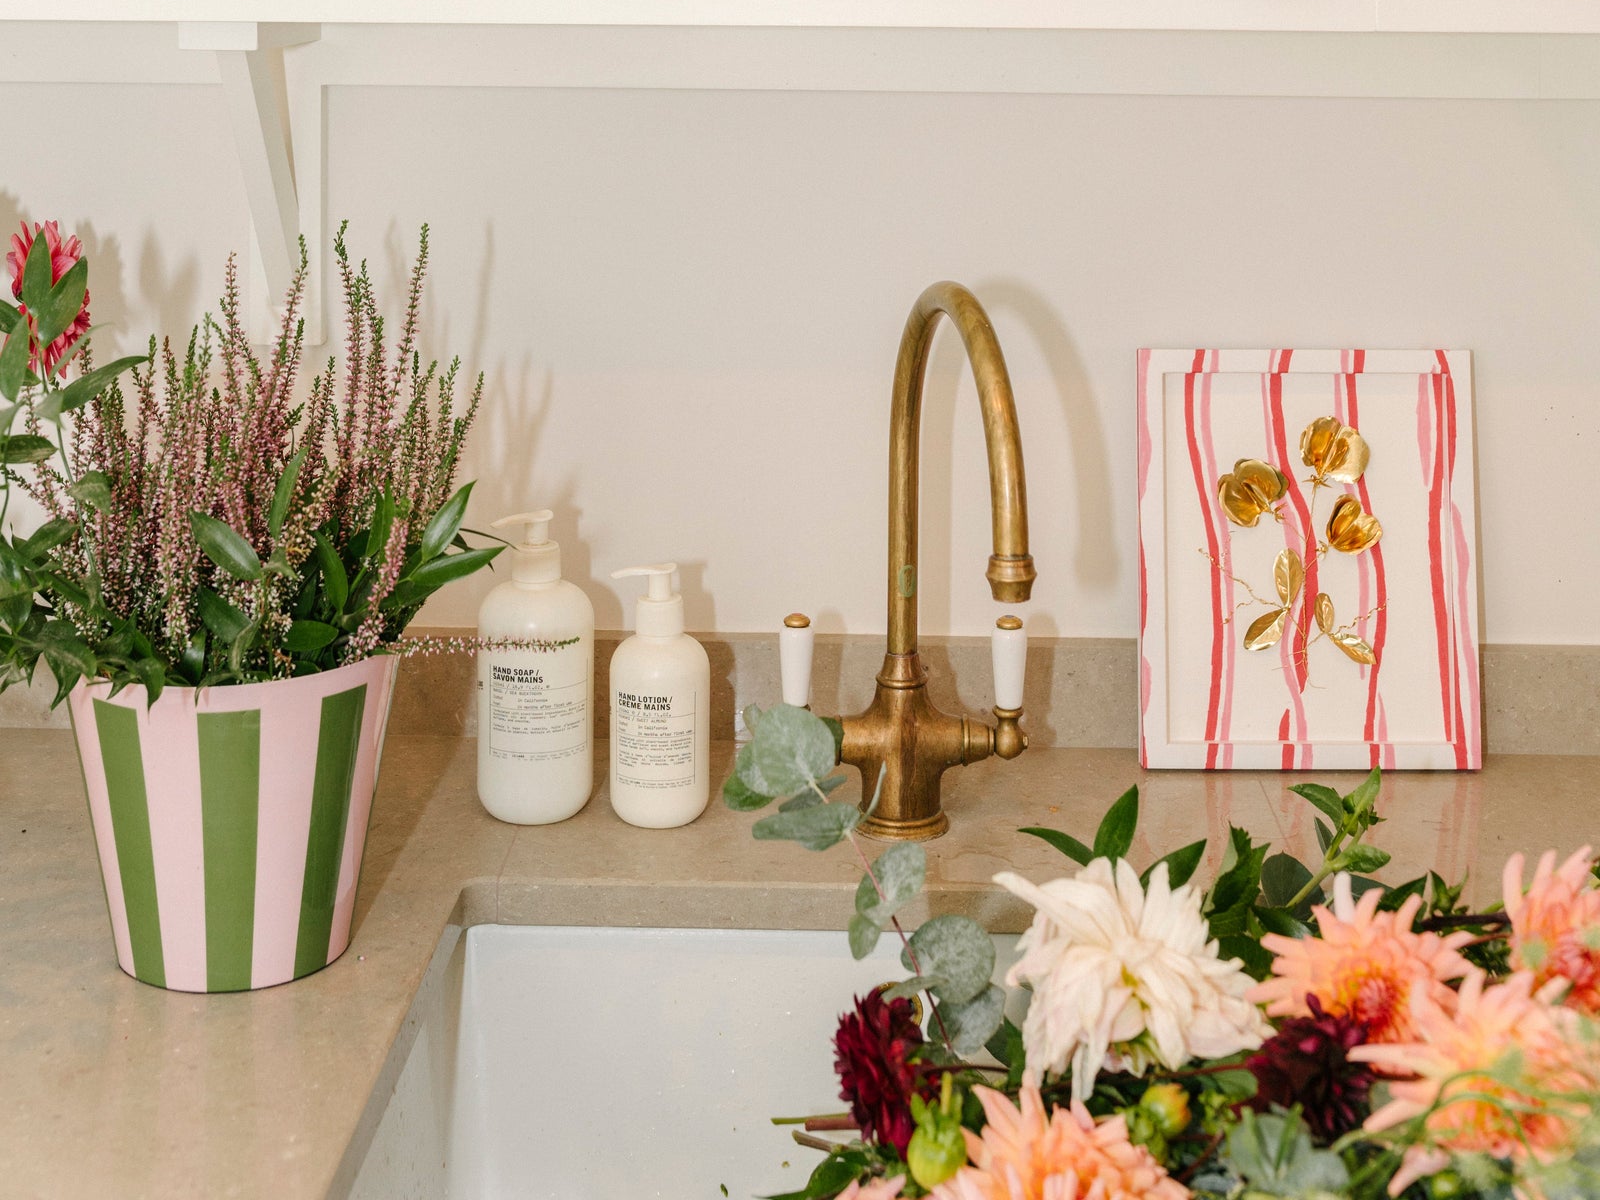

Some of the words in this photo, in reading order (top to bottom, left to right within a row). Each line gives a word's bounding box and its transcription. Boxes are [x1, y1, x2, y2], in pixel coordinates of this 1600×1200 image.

[492, 666, 512, 675] HAND
[513, 668, 534, 676] SOAP
[492, 673, 515, 682] SAVON
[517, 676, 544, 684] MAINS
[618, 692, 636, 702] HAND
[638, 696, 667, 704] LOTION
[643, 703, 671, 711] MAINS
